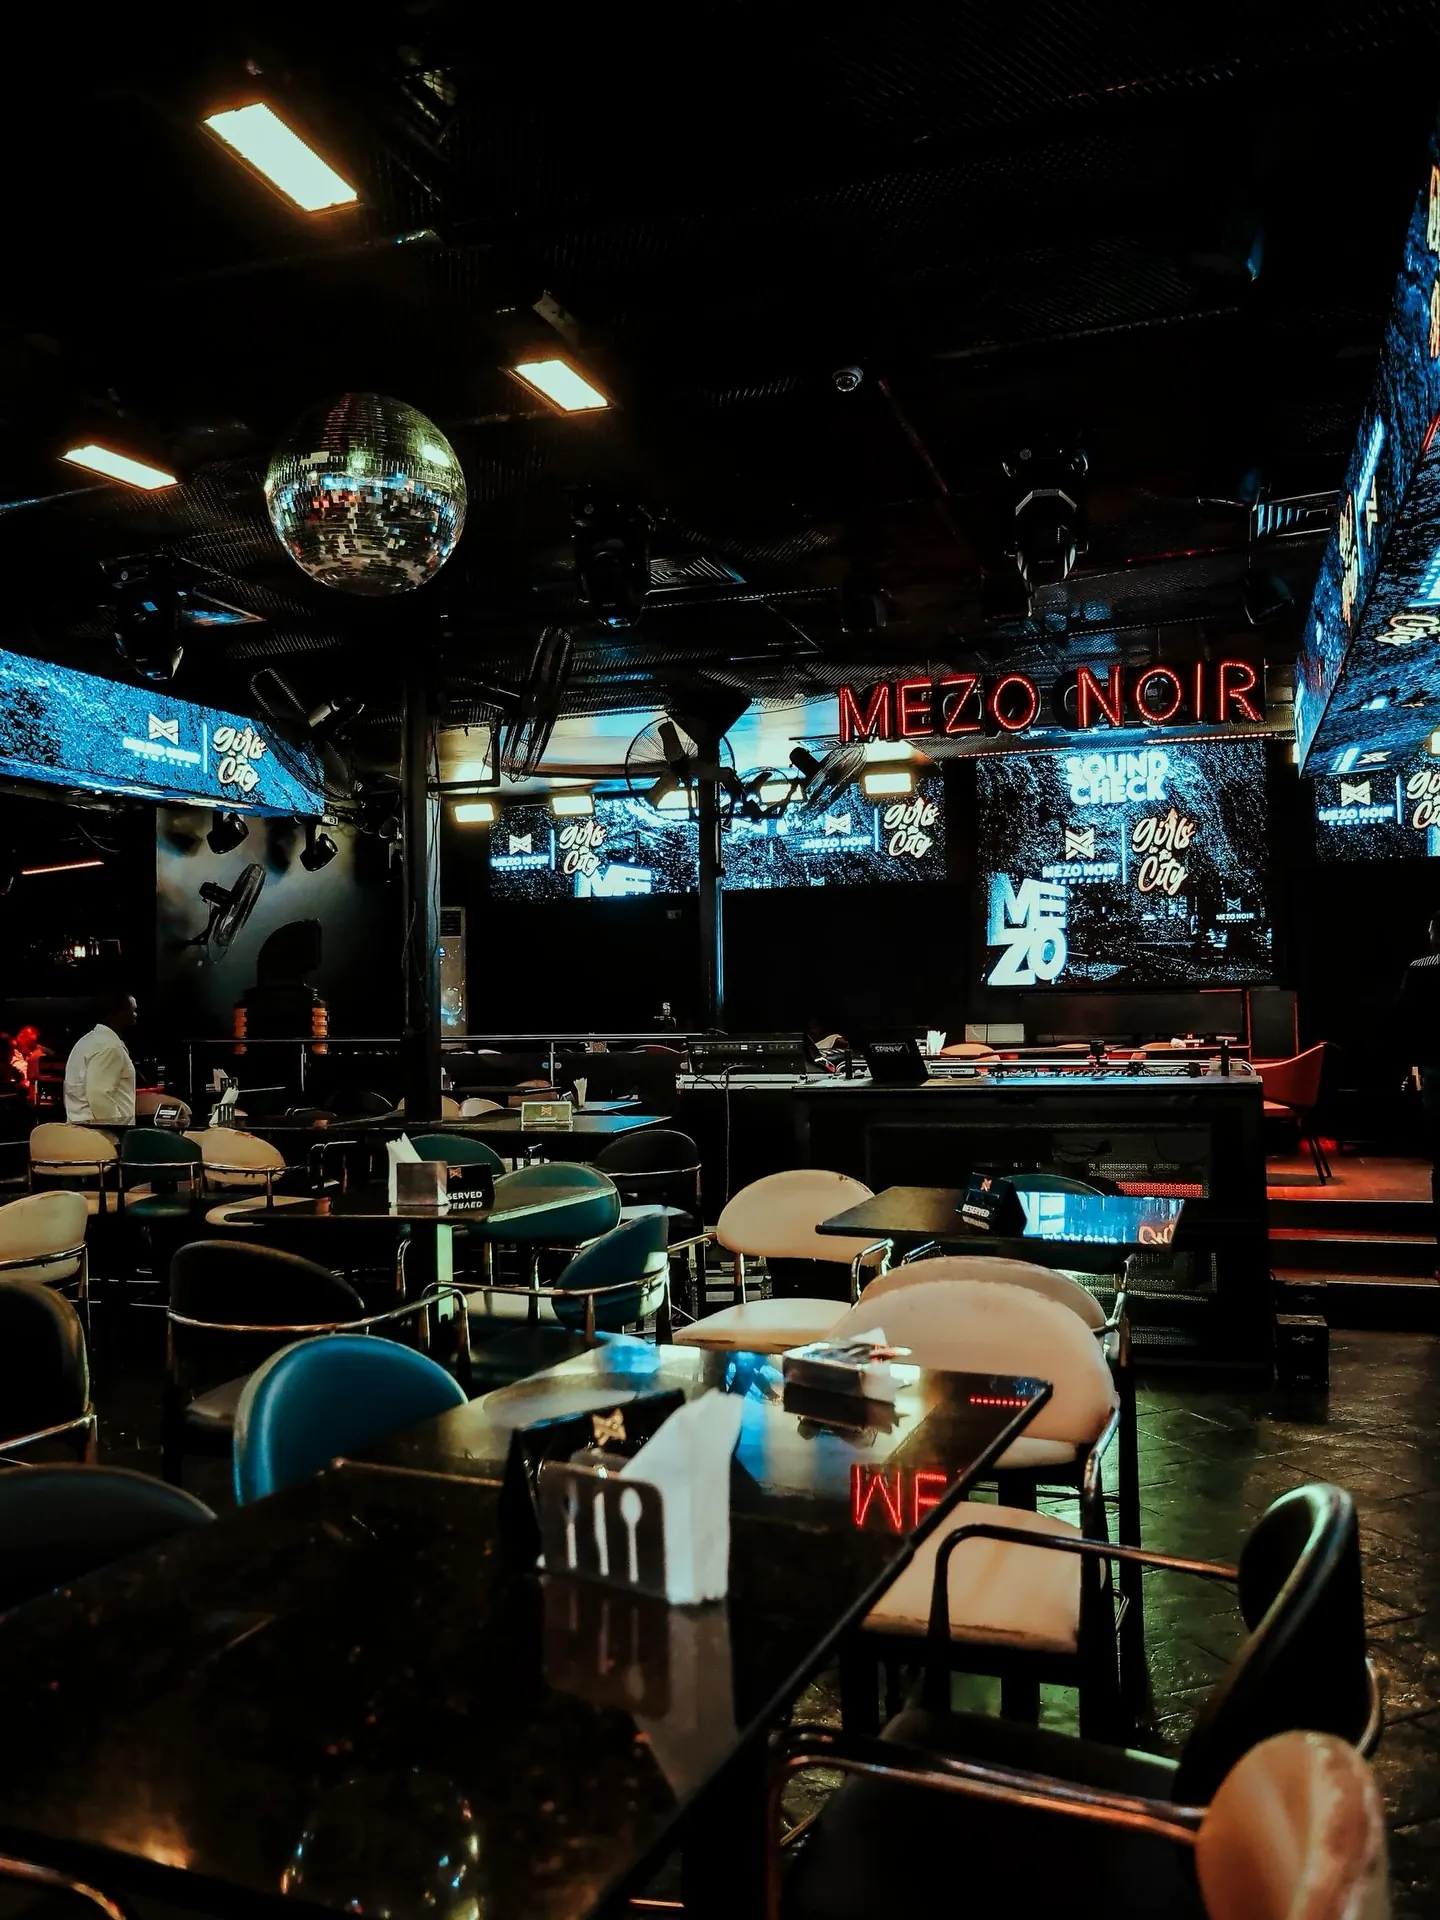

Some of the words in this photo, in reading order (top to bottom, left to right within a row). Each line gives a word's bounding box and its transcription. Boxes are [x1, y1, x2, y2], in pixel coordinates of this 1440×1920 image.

[839, 671, 1038, 742] MEZO
[1077, 660, 1265, 729] NOIR
[1065, 751, 1170, 783] SOUND
[1069, 775, 1168, 805] CHECK
[1042, 863, 1082, 878] MEZO
[1083, 862, 1120, 877] NOIR
[447, 1191, 483, 1200] SERVED
